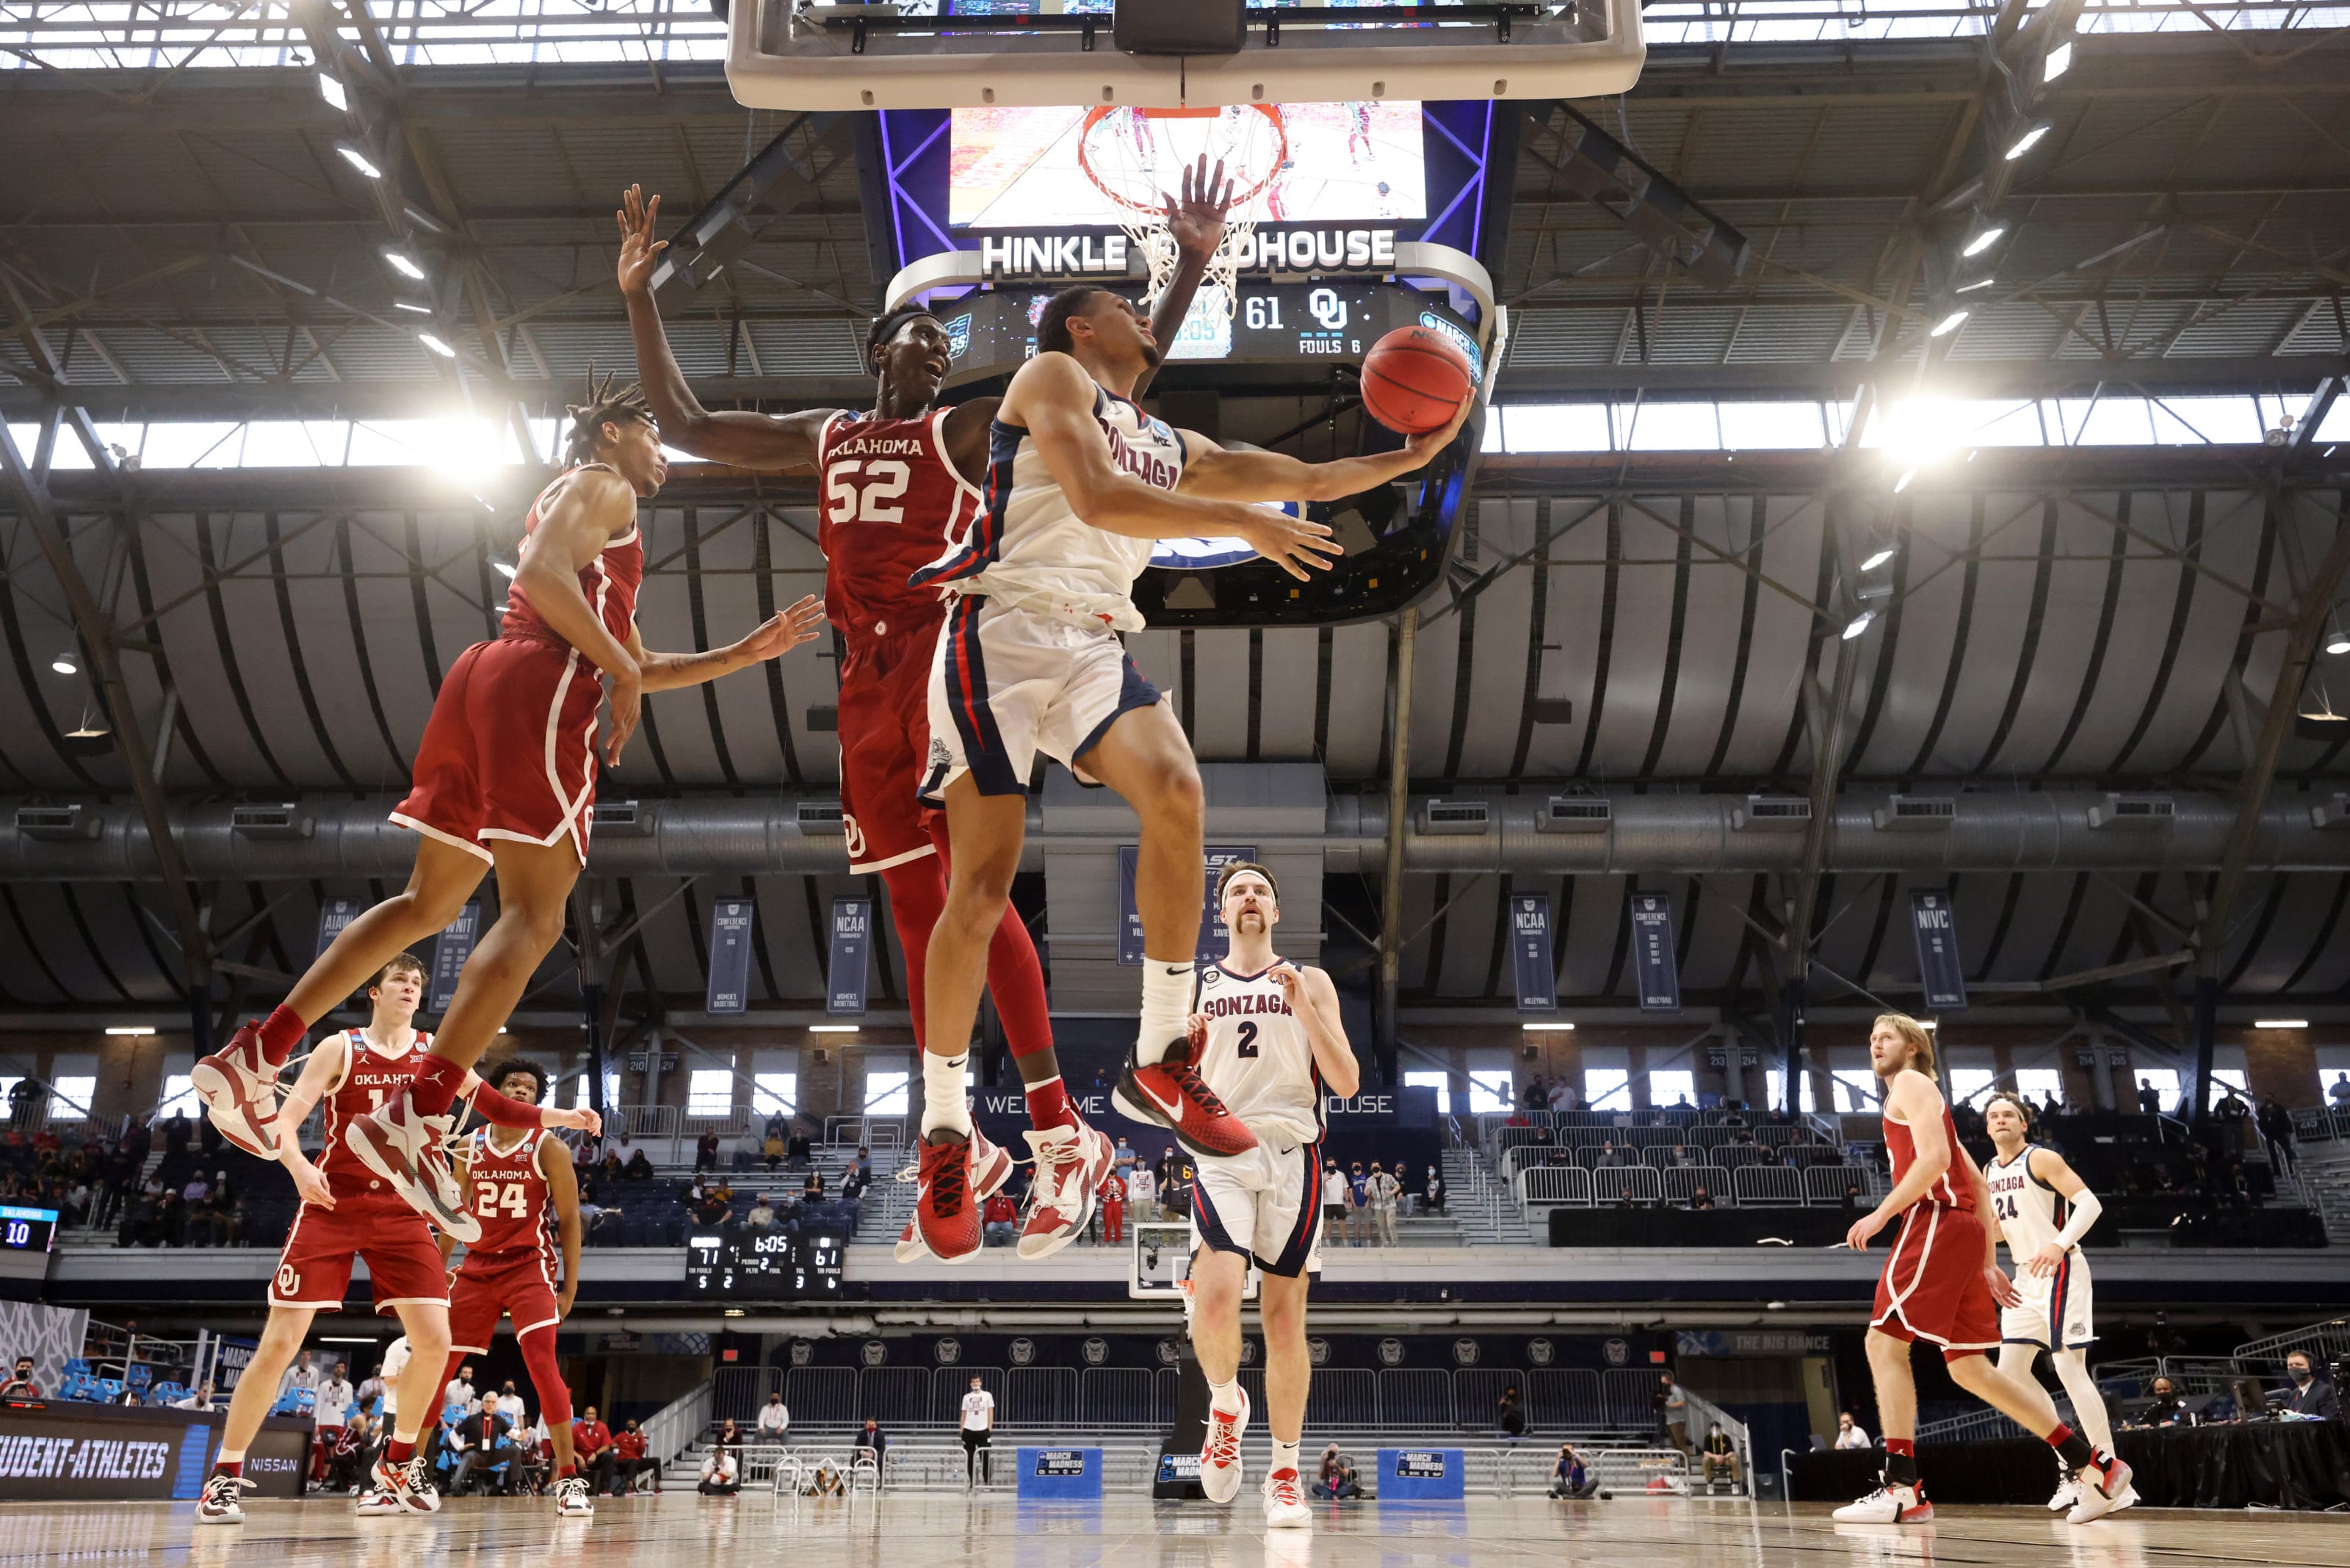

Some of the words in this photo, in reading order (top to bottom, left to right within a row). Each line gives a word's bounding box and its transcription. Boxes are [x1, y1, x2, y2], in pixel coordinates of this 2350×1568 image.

[983, 235, 1127, 275] HINKLE
[1246, 297, 1284, 329] 61
[1309, 289, 1347, 329] OU
[1299, 340, 1342, 353] FOULS
[1352, 340, 1361, 353] 6
[828, 459, 911, 524] 52
[717, 917, 748, 925] CONFERENCE
[836, 917, 864, 932] NCAA
[1516, 913, 1545, 929] NCAA
[1636, 913, 1667, 921] CONFERENCE
[1918, 910, 1948, 928] NIVC
[1237, 1021, 1259, 1058] 2
[630, 1061, 645, 1071] 210
[472, 1170, 532, 1180] OKLAHOMA
[477, 1181, 527, 1218] 24
[1995, 1195, 2019, 1221] 24
[6, 1223, 29, 1244] 10
[755, 1236, 787, 1253] 6:05
[700, 1249, 718, 1265] 71
[760, 1257, 769, 1270] 2
[815, 1250, 836, 1265] 61
[278, 1264, 300, 1296] OU
[723, 1276, 733, 1289] 2
[796, 1276, 804, 1289] 3
[1736, 1336, 1760, 1350] THE
[1762, 1335, 1785, 1350] BIG
[1787, 1335, 1830, 1350] DANCE
[1046, 1452, 1072, 1460] MARCH
[1406, 1453, 1432, 1462] MARCH
[250, 1458, 297, 1473] NISSAN
[1048, 1460, 1083, 1469] MADNESS
[1409, 1462, 1445, 1471] MADNESS
